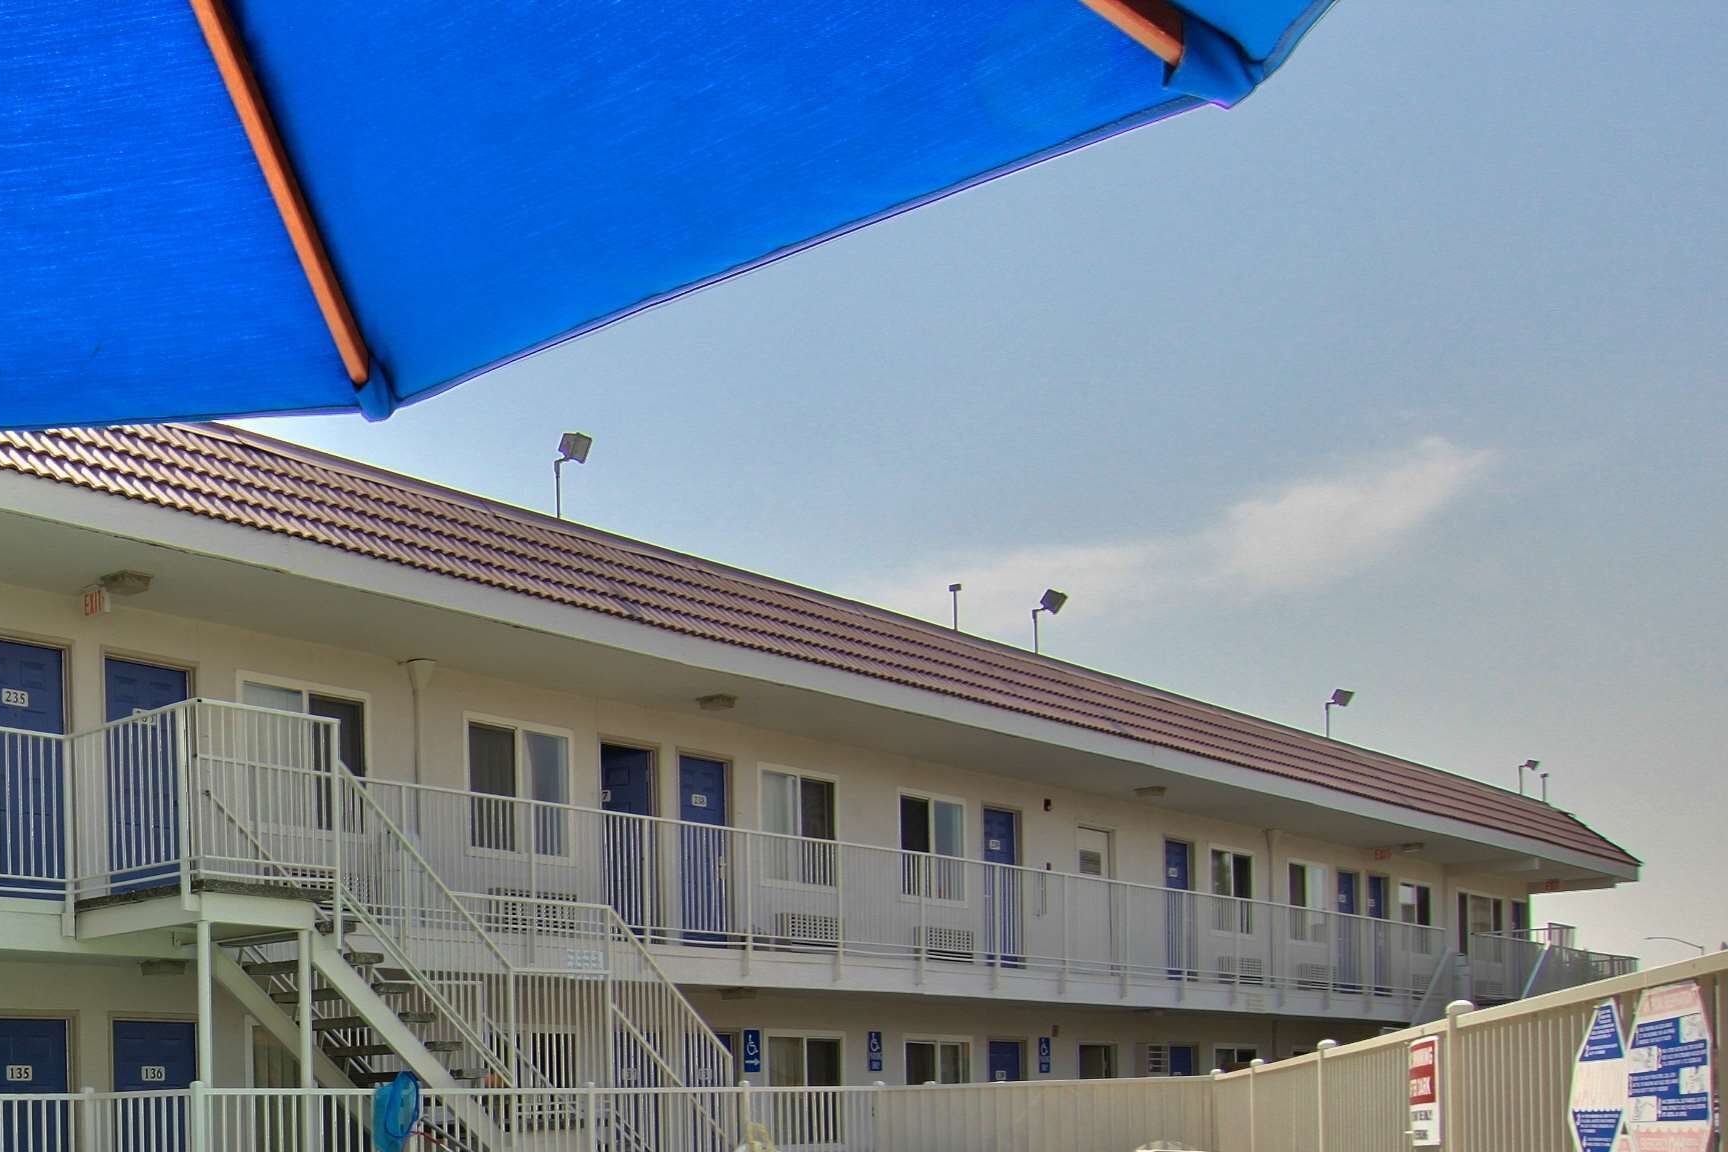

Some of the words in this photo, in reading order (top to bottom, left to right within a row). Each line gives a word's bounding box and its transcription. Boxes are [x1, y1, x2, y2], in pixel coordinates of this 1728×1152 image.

[5, 690, 26, 705] 235
[9, 1067, 30, 1080] 135
[143, 1068, 164, 1080] 136
